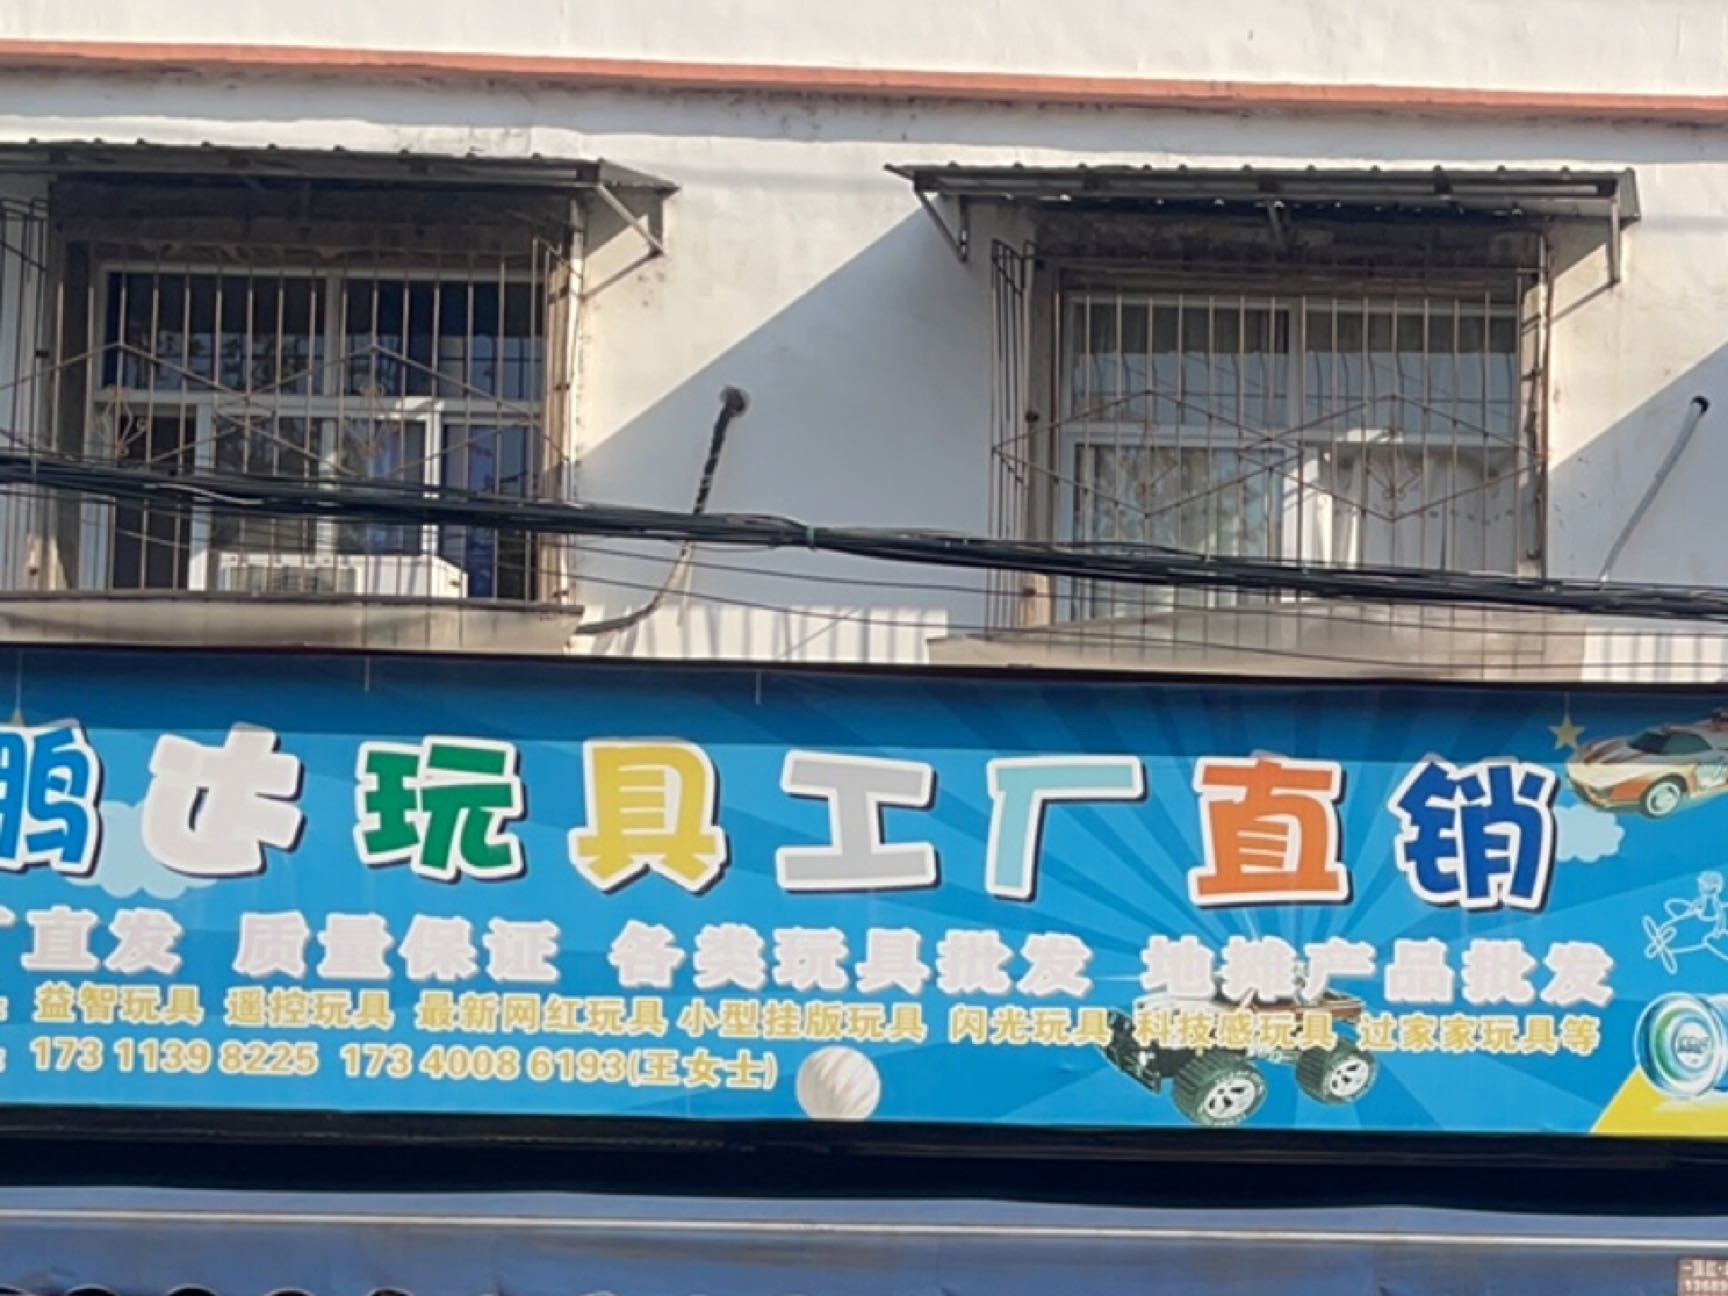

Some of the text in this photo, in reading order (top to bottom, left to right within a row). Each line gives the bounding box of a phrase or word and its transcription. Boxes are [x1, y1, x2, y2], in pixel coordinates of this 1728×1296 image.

[0, 906, 183, 974] 直发
[232, 911, 560, 982] 质量保证
[608, 920, 1093, 997] 各类玩具批发
[34, 984, 1601, 1057] 益智玩具 遥控玩具 最新网红玩具 小型挂版玩具 闪光玩具 科技感玩具 过家家玩具等
[30, 1036, 778, 1091] 173 1139 8225 173 4008 6193(王女士)
